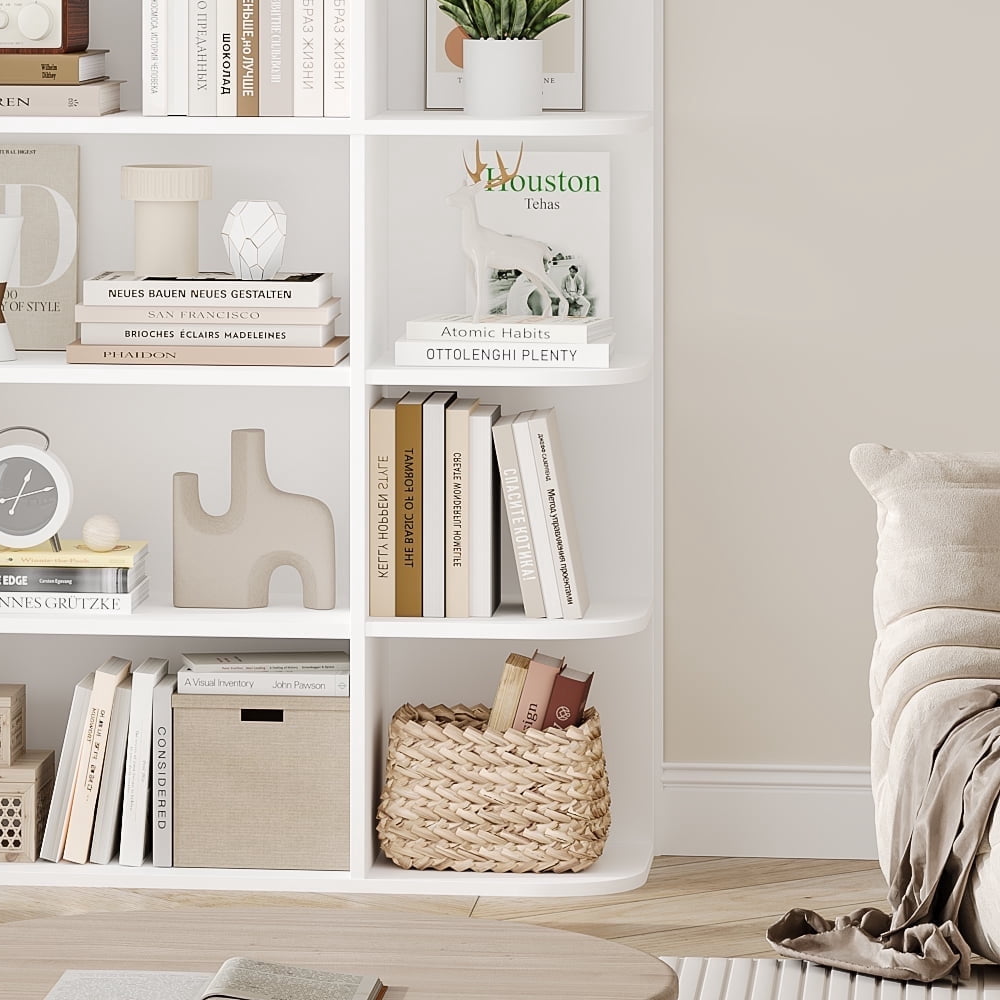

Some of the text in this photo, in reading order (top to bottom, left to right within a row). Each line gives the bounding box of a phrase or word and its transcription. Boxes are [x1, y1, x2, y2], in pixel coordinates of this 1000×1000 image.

[195, 0, 208, 10] О
[195, 14, 208, 90] ПРЕДАННЫХ
[220, 33, 231, 95] ШОКОЛАД
[302, 38, 314, 90] ЖИЗНИ
[333, 38, 345, 90] ЖИЗНИ
[485, 168, 601, 193] Houston
[524, 198, 560, 210] Tehas
[108, 289, 292, 299] NEUES BAUEN NEUES GESTALTEN
[10, 302, 24, 311] OF
[26, 302, 61, 312] STYLE
[148, 311, 260, 319] SAN FRANCISCO
[125, 328, 286, 339] BRIOCHES ÉCLAIRS MADELEINES
[441, 326, 551, 339] Atomic Habits
[426, 349, 577, 361] OTTOLENGHI PLENTY
[503, 468, 536, 581] СПАСИТЕ КОТИКА!
[3, 575, 28, 585] EDGE
[45, 595, 120, 610] GRÜTZKE
[193, 678, 215, 686] Visual
[218, 679, 254, 688] Inventory
[158, 727, 166, 830] CONSIDERED
